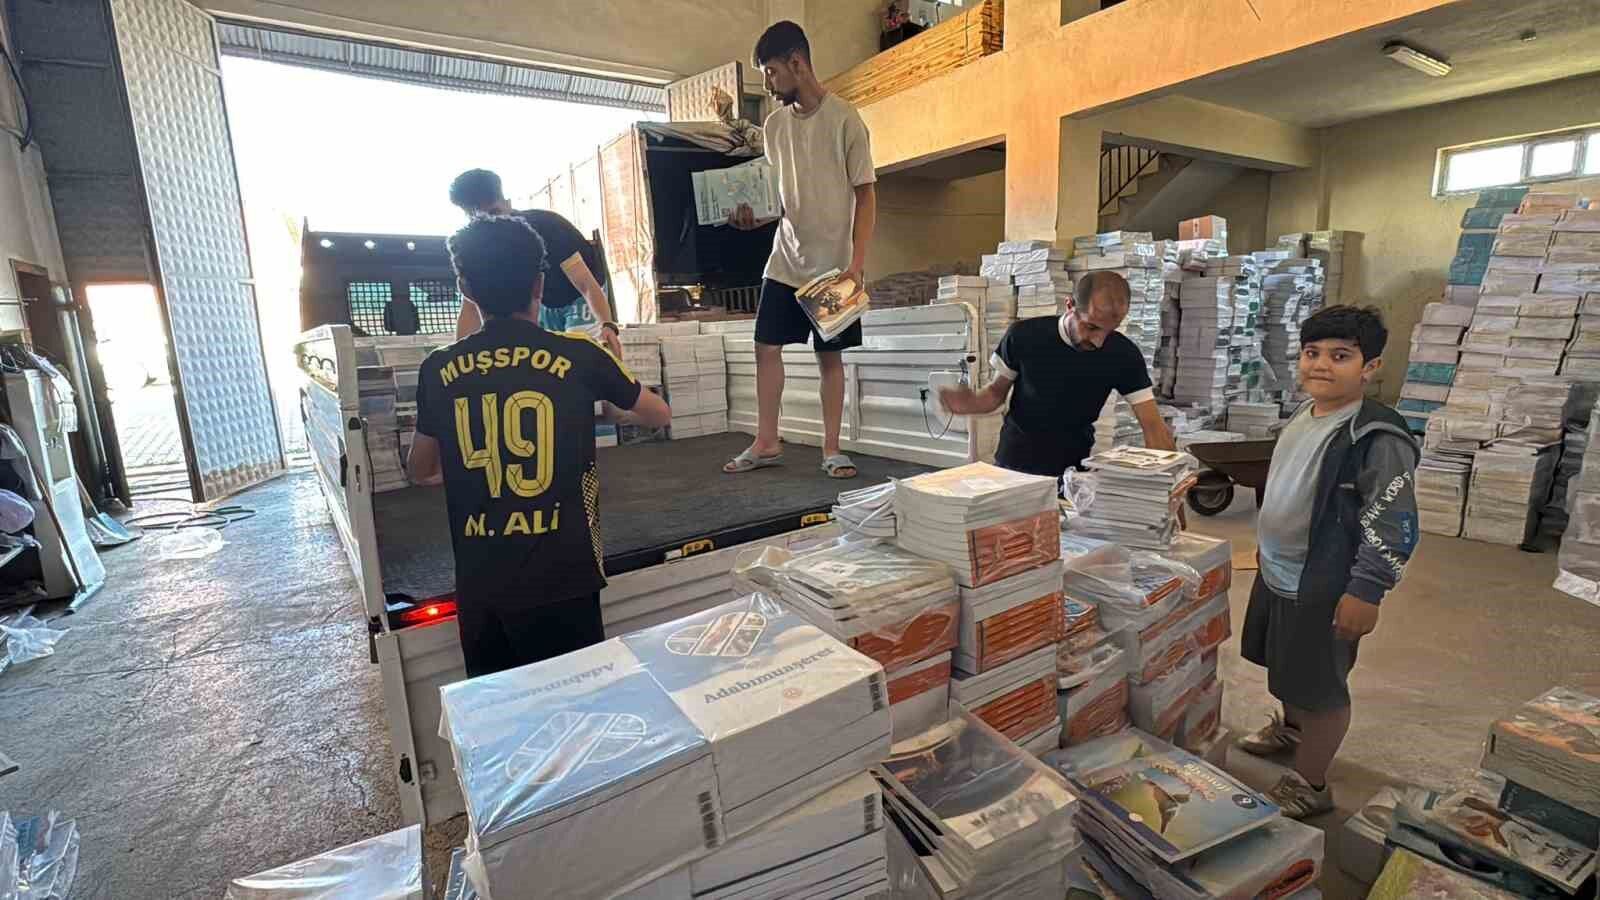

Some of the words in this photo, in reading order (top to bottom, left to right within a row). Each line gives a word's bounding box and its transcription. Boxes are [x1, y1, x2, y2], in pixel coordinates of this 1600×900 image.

[439, 346, 573, 387] MUŞSPOR
[454, 389, 556, 499] 49
[464, 513, 496, 538] M.
[503, 501, 561, 536] ALİ
